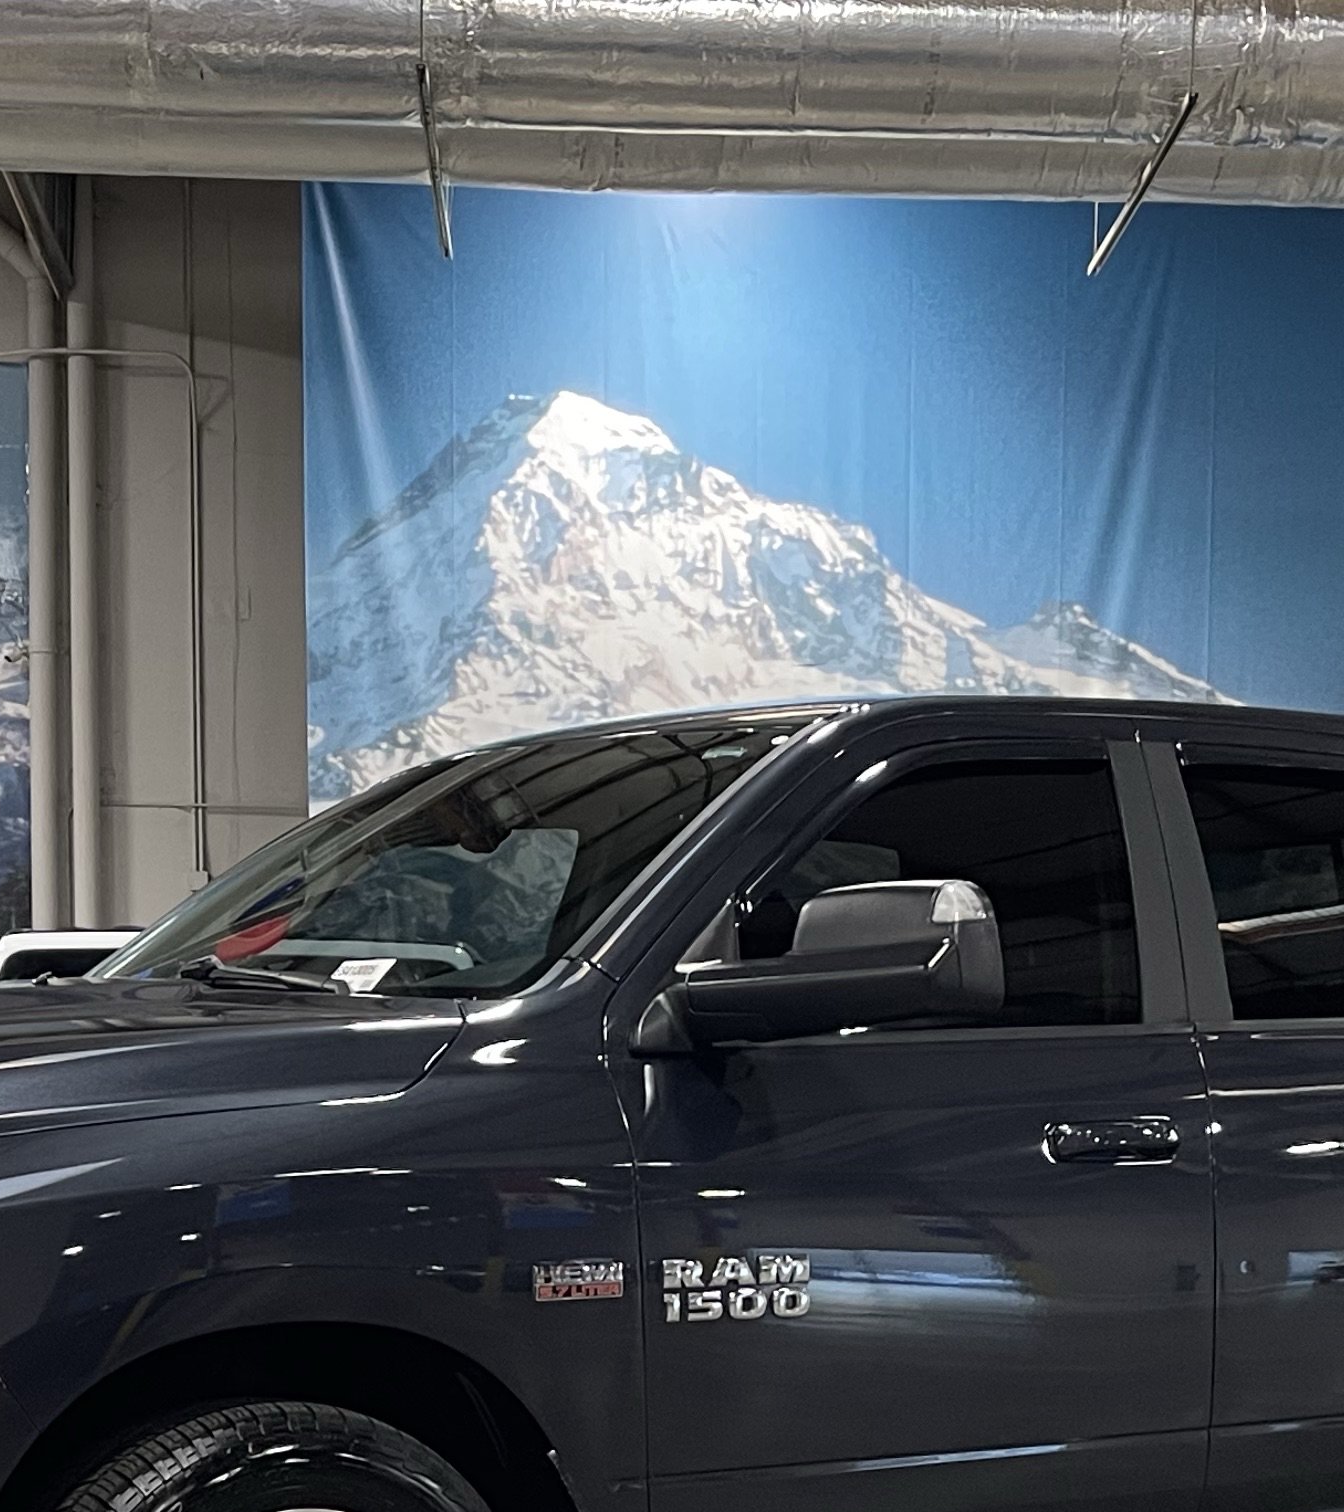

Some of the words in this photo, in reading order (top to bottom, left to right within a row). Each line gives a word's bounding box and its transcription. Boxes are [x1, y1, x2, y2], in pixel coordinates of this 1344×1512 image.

[533, 1261, 623, 1284] HEMI
[663, 1254, 810, 1288] RAM
[664, 1287, 810, 1323] 1500
